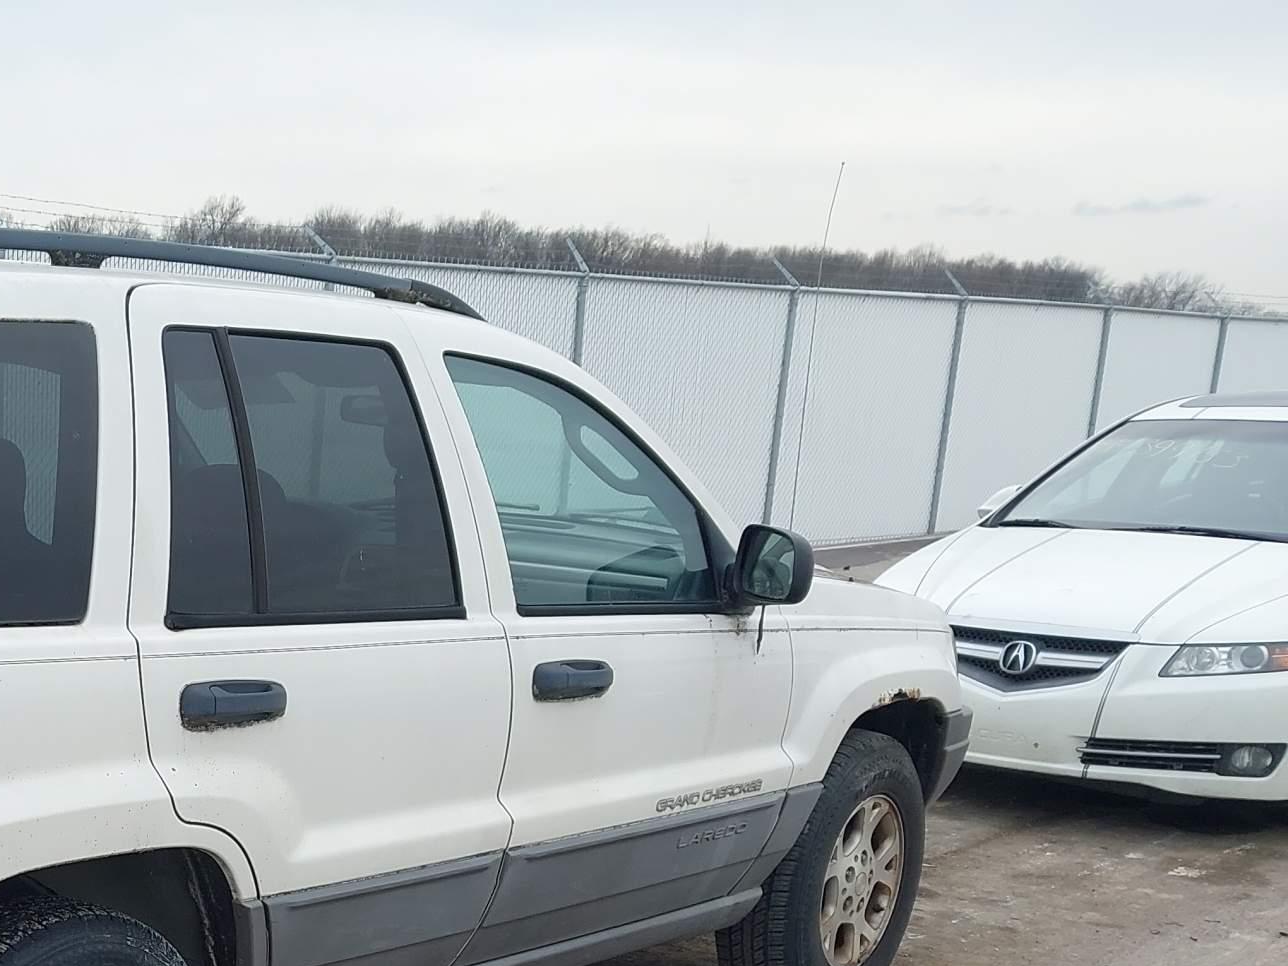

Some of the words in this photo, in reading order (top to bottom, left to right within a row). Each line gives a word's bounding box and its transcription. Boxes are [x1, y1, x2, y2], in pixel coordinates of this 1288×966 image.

[655, 792, 700, 813] GRAND
[701, 779, 763, 803] CHEROKEE
[676, 822, 748, 850] LAREDO
